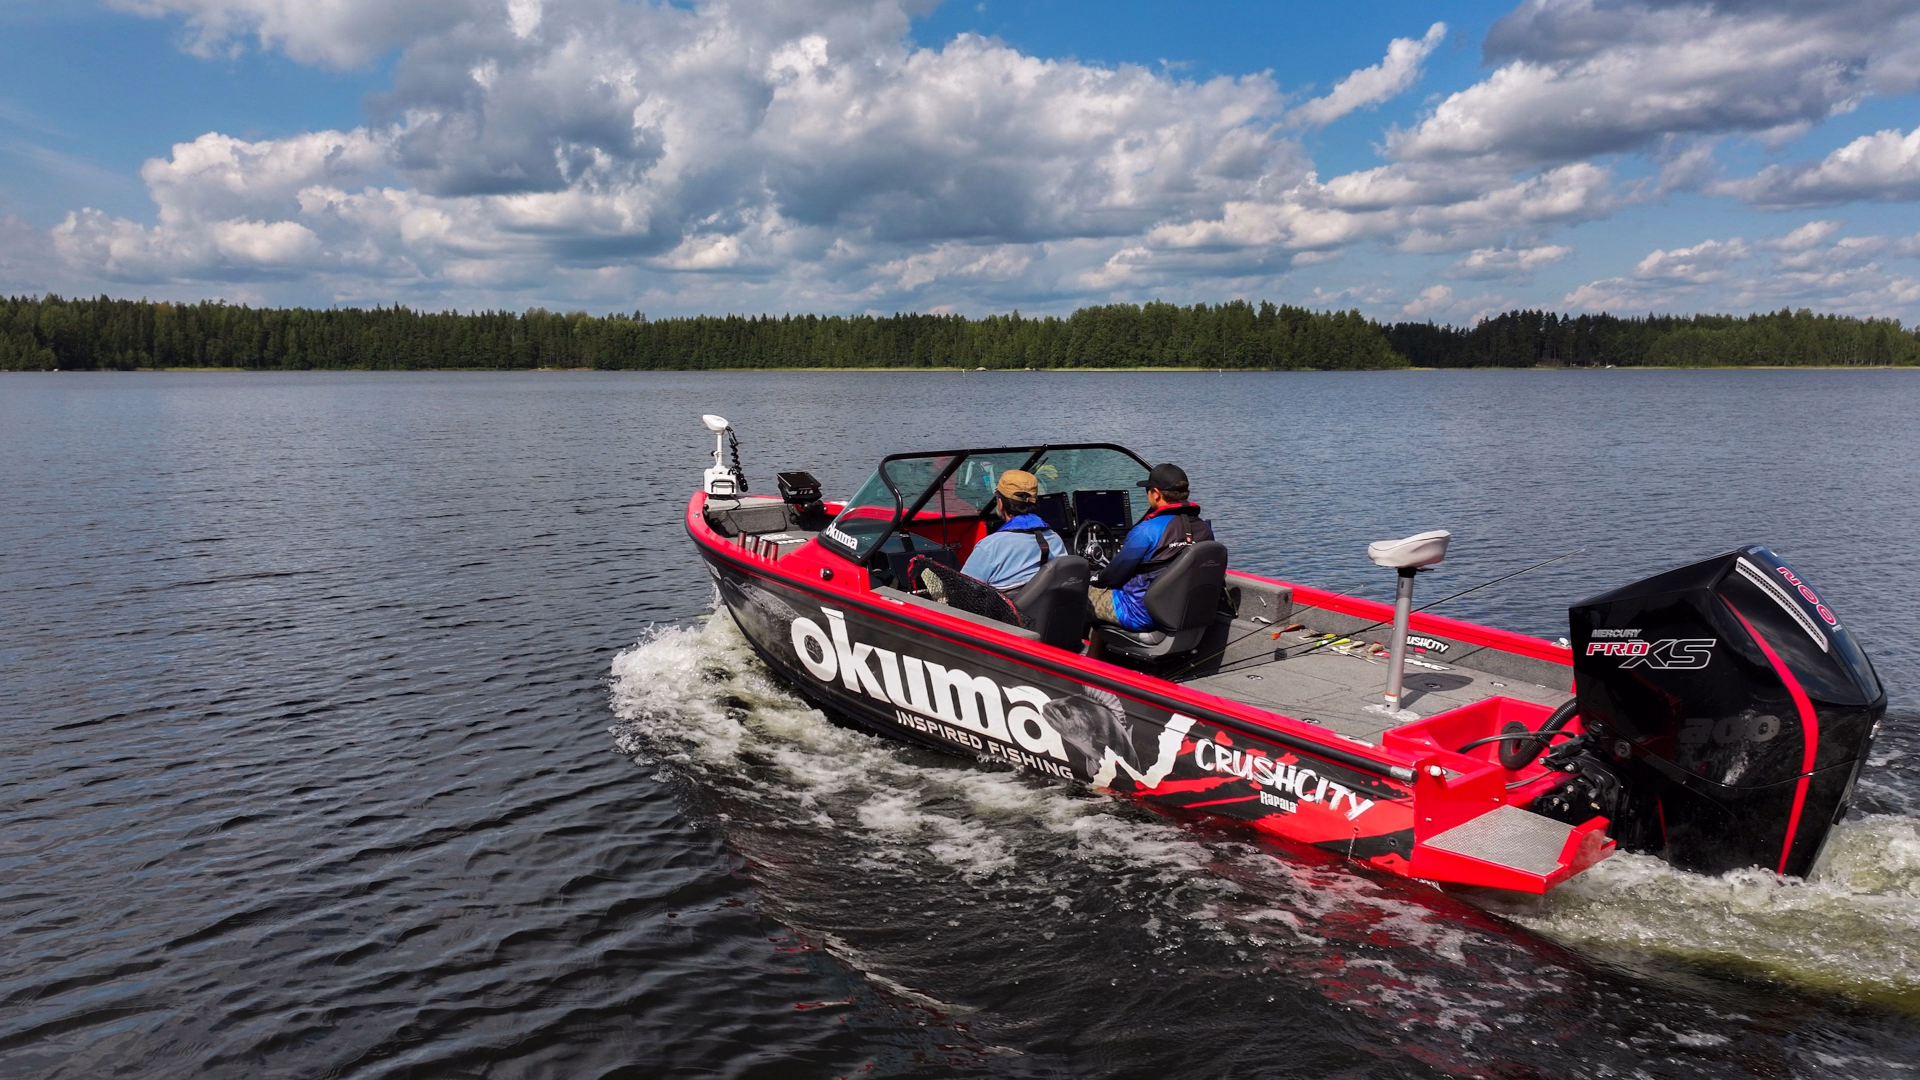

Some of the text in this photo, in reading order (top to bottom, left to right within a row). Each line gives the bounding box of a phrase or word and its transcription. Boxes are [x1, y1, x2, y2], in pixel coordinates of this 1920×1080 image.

[826, 522, 858, 550] okuma
[1776, 566, 1836, 625] 200
[1406, 635, 1449, 652] USHCITY
[1591, 629, 1642, 638] MERCURY
[1586, 642, 1650, 656] PRO
[791, 606, 1069, 762] okuma
[1678, 715, 1780, 744] 200
[895, 710, 1074, 779] INSPIRED FISHING
